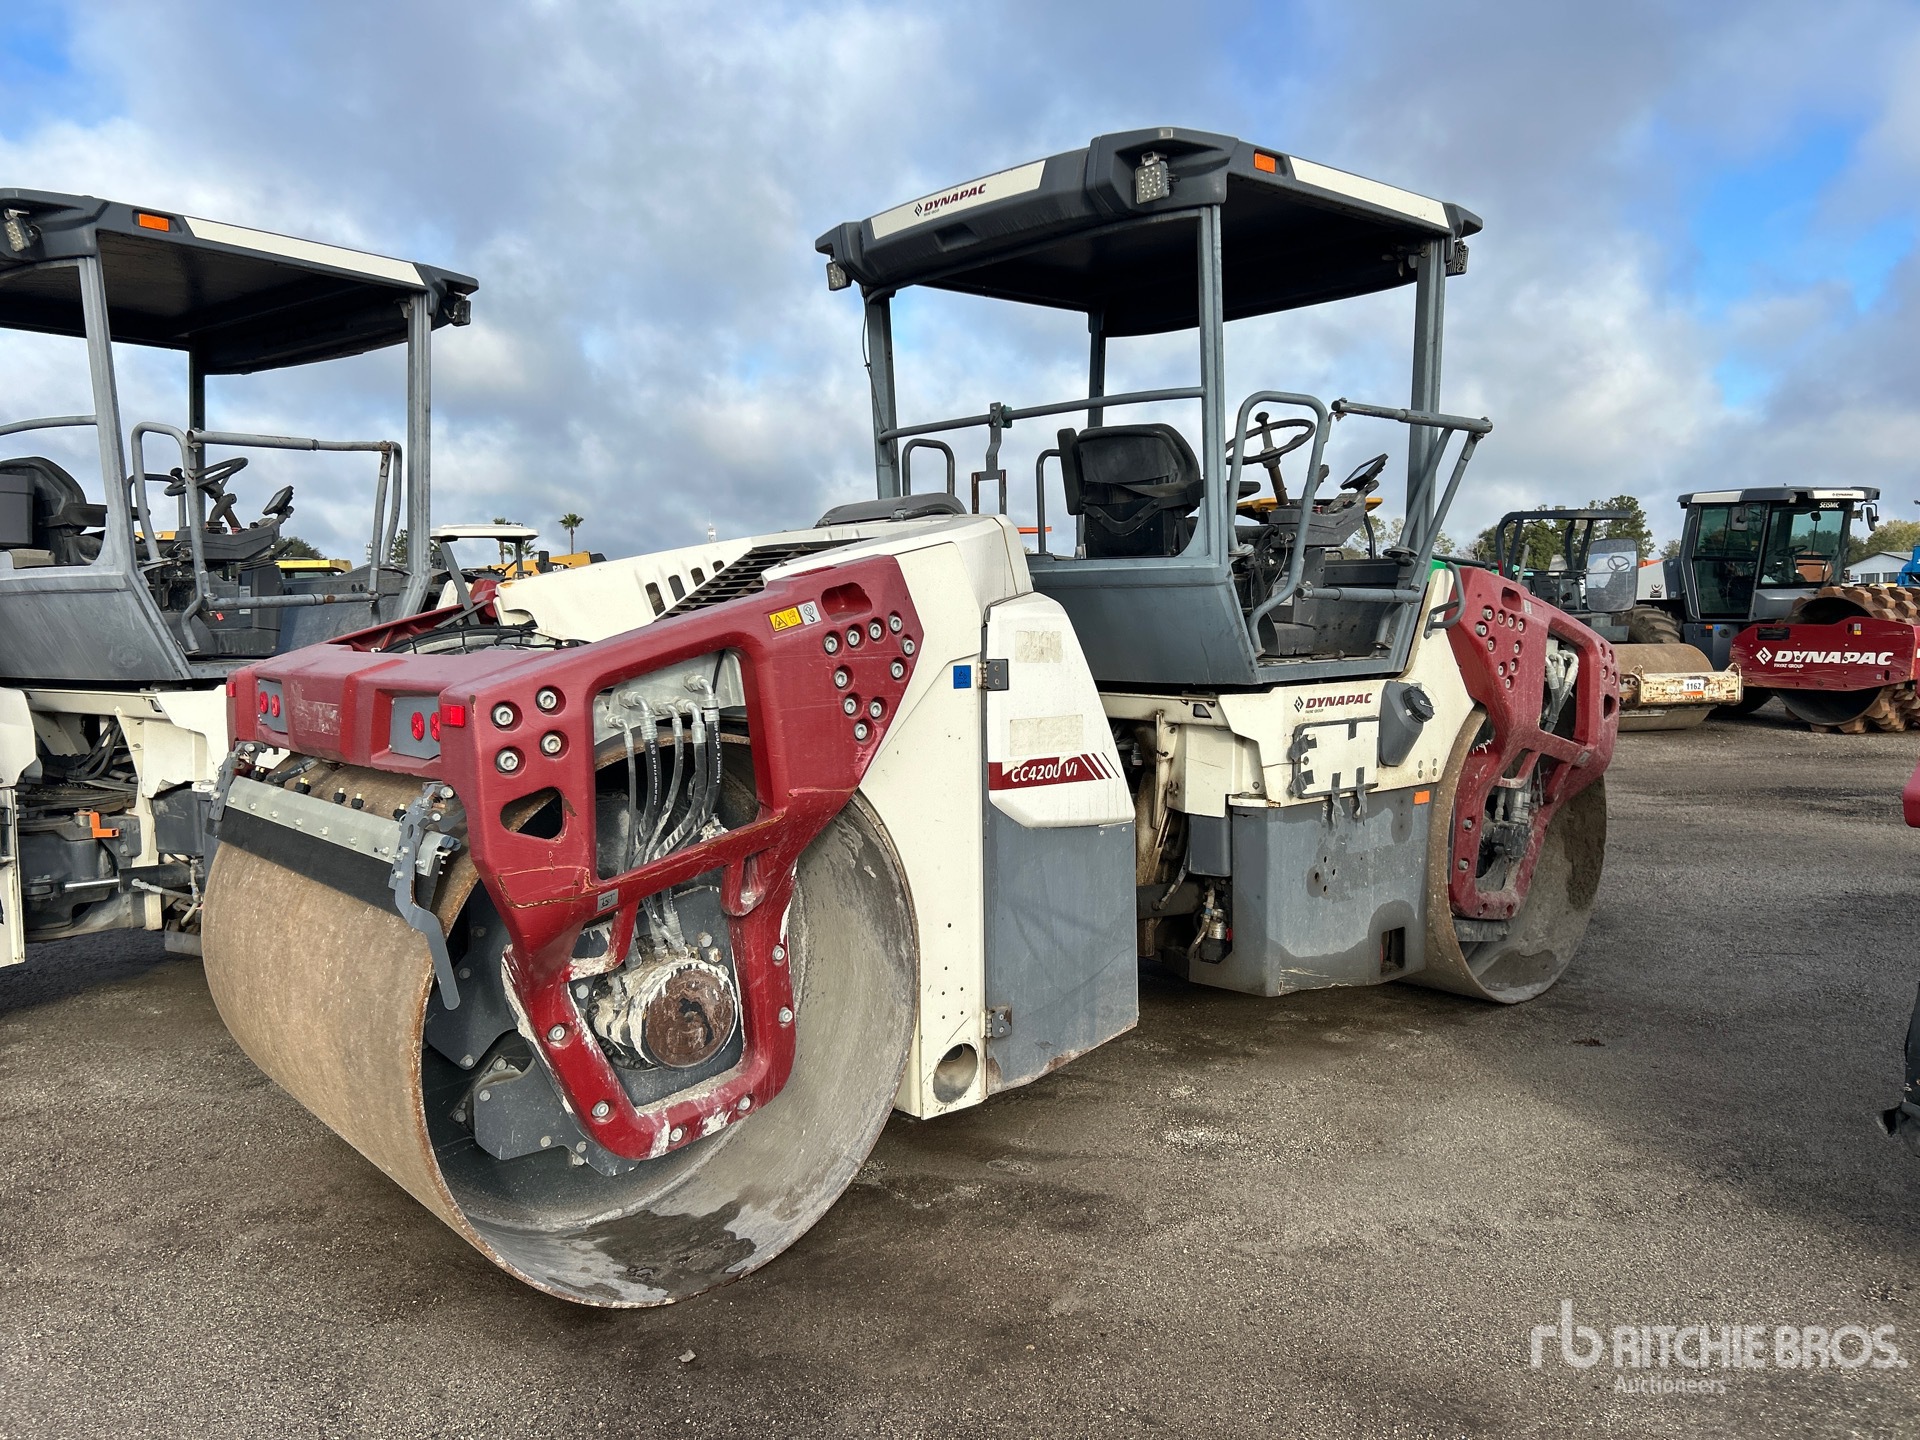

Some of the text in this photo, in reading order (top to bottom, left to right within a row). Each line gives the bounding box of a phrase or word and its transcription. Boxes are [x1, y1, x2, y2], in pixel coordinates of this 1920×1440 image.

[924, 184, 986, 212] DYNAPAC
[1819, 501, 1840, 509] SEISMIC
[1773, 650, 1894, 666] DYNAPAC
[1686, 682, 1702, 690] 1162
[1305, 692, 1373, 709] DYNAPAC
